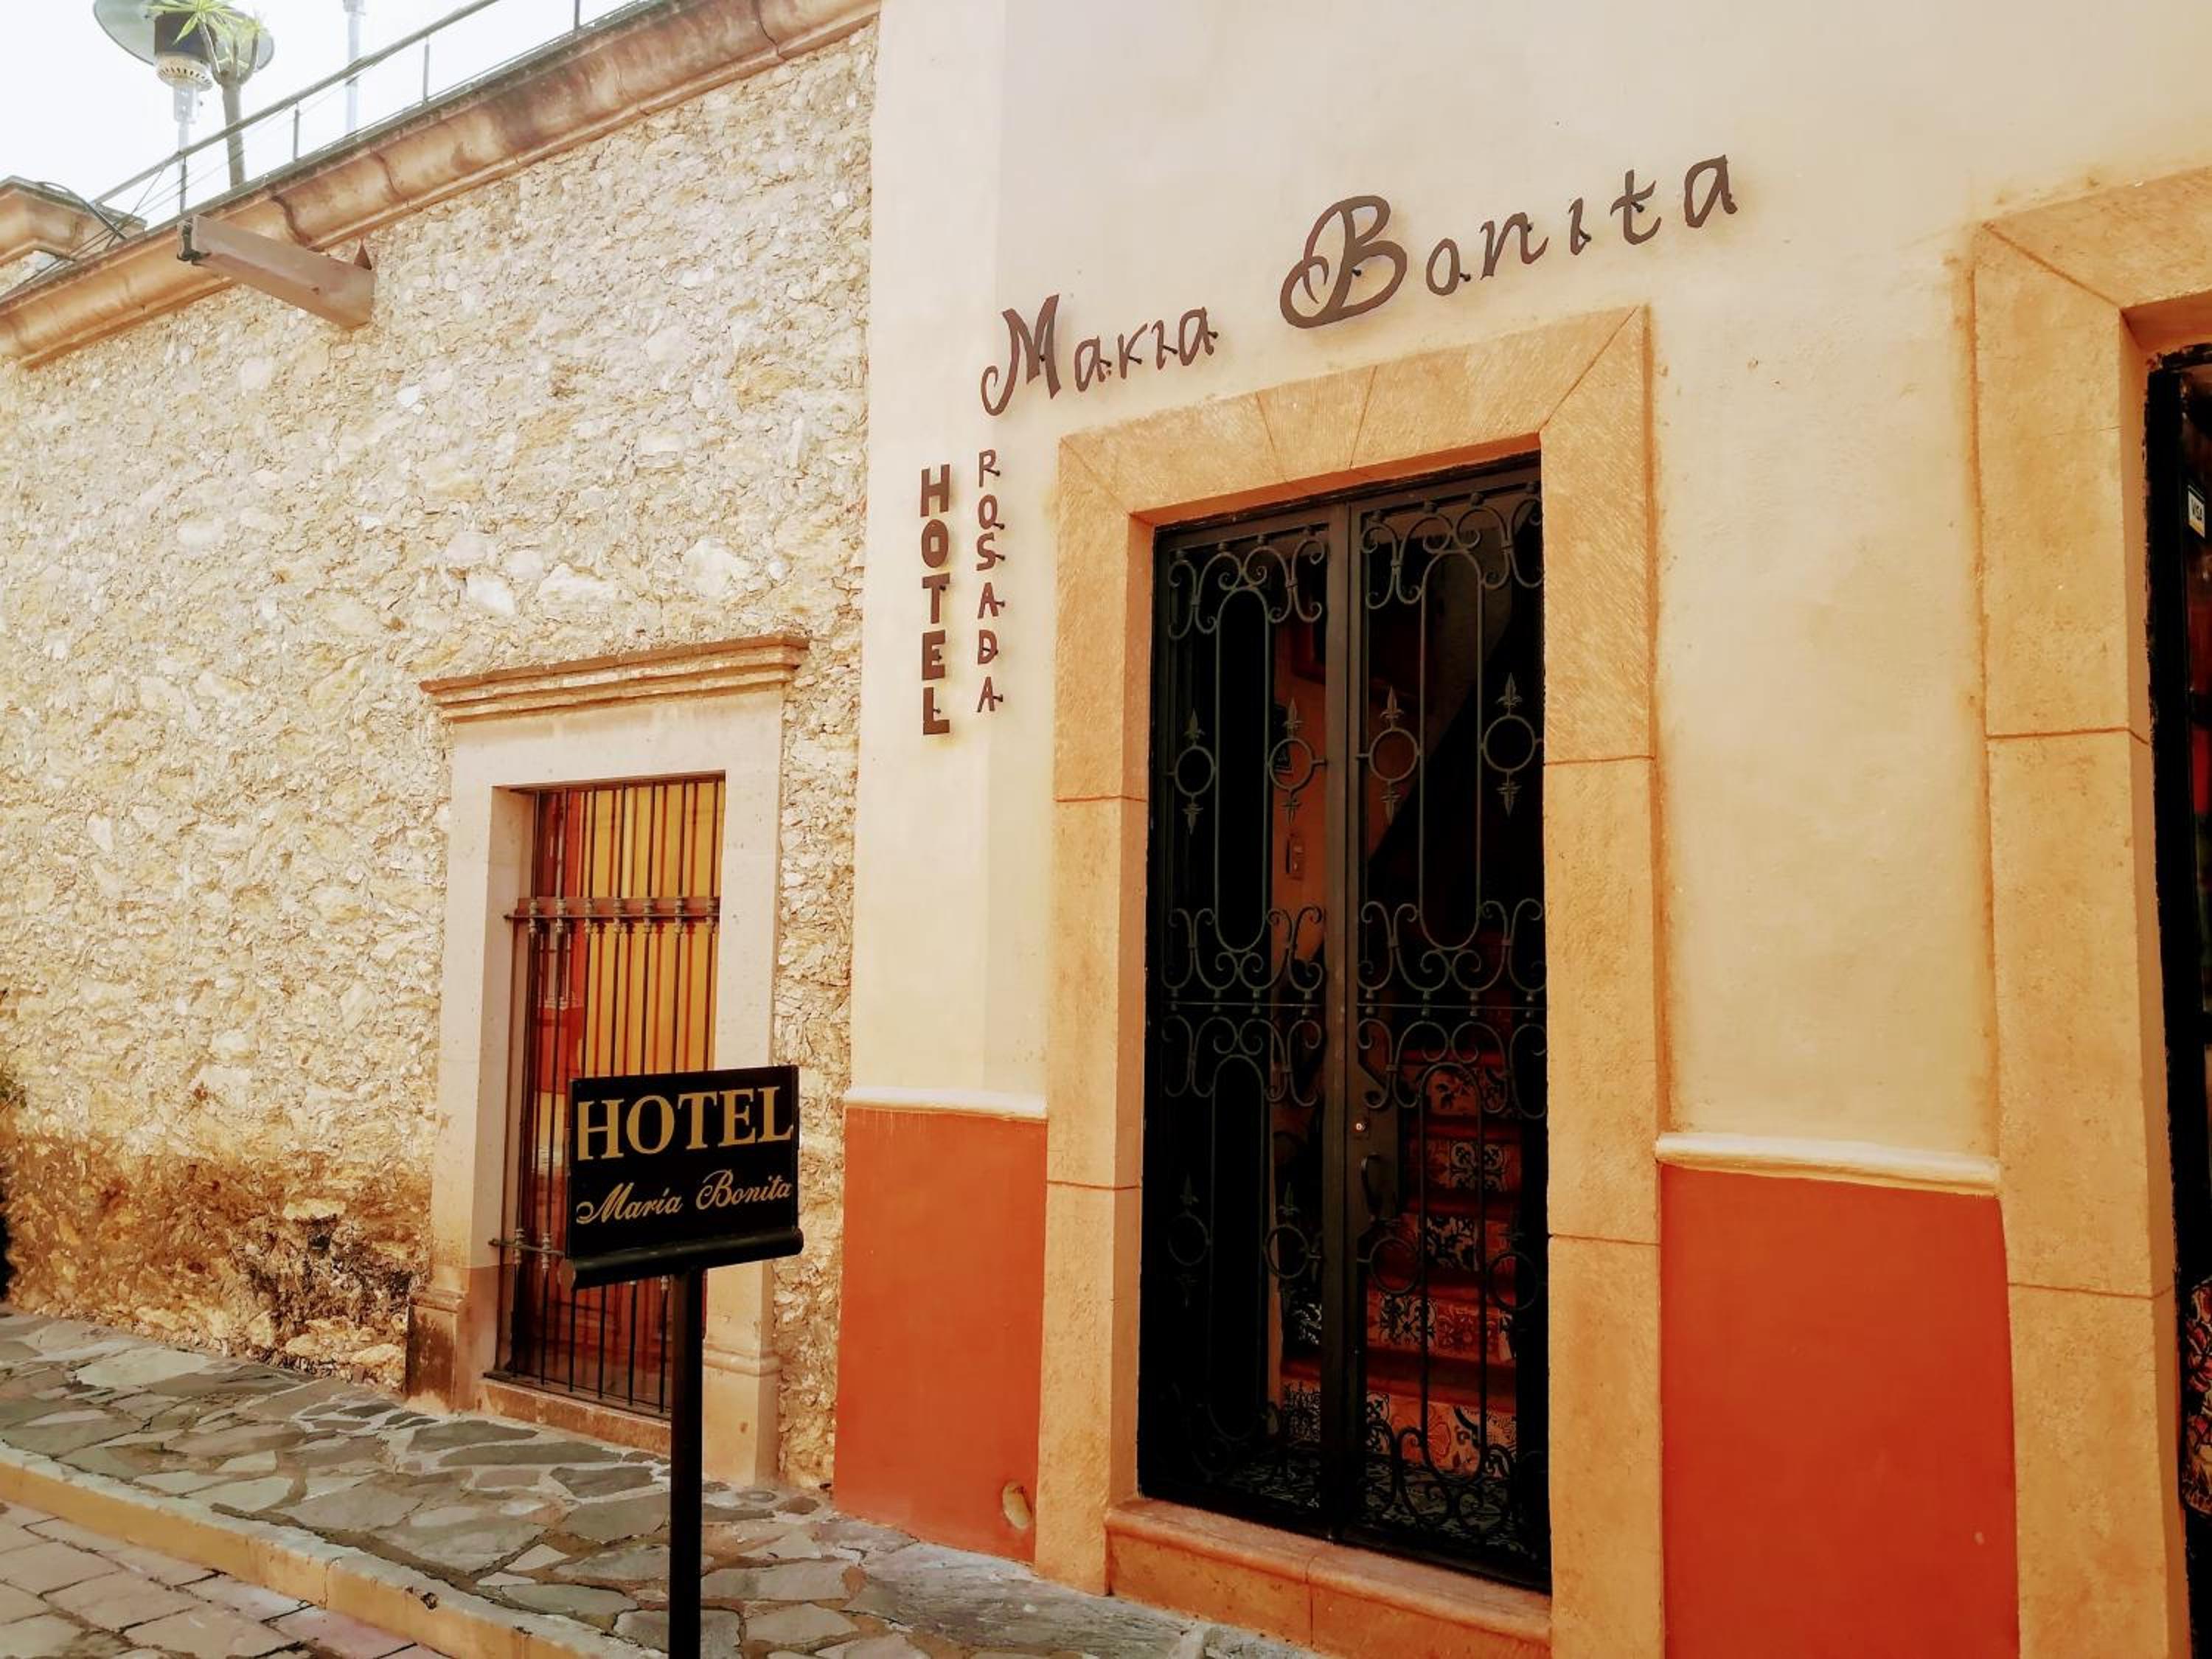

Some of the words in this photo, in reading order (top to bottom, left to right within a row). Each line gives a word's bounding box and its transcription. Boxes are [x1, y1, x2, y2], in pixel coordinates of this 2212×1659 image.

[1280, 155, 1738, 329] Bonita
[920, 464, 950, 735] HOTEL
[577, 1086, 794, 1161] HOTEL
[576, 1182, 684, 1224] María
[696, 1169, 793, 1210] Bonita
